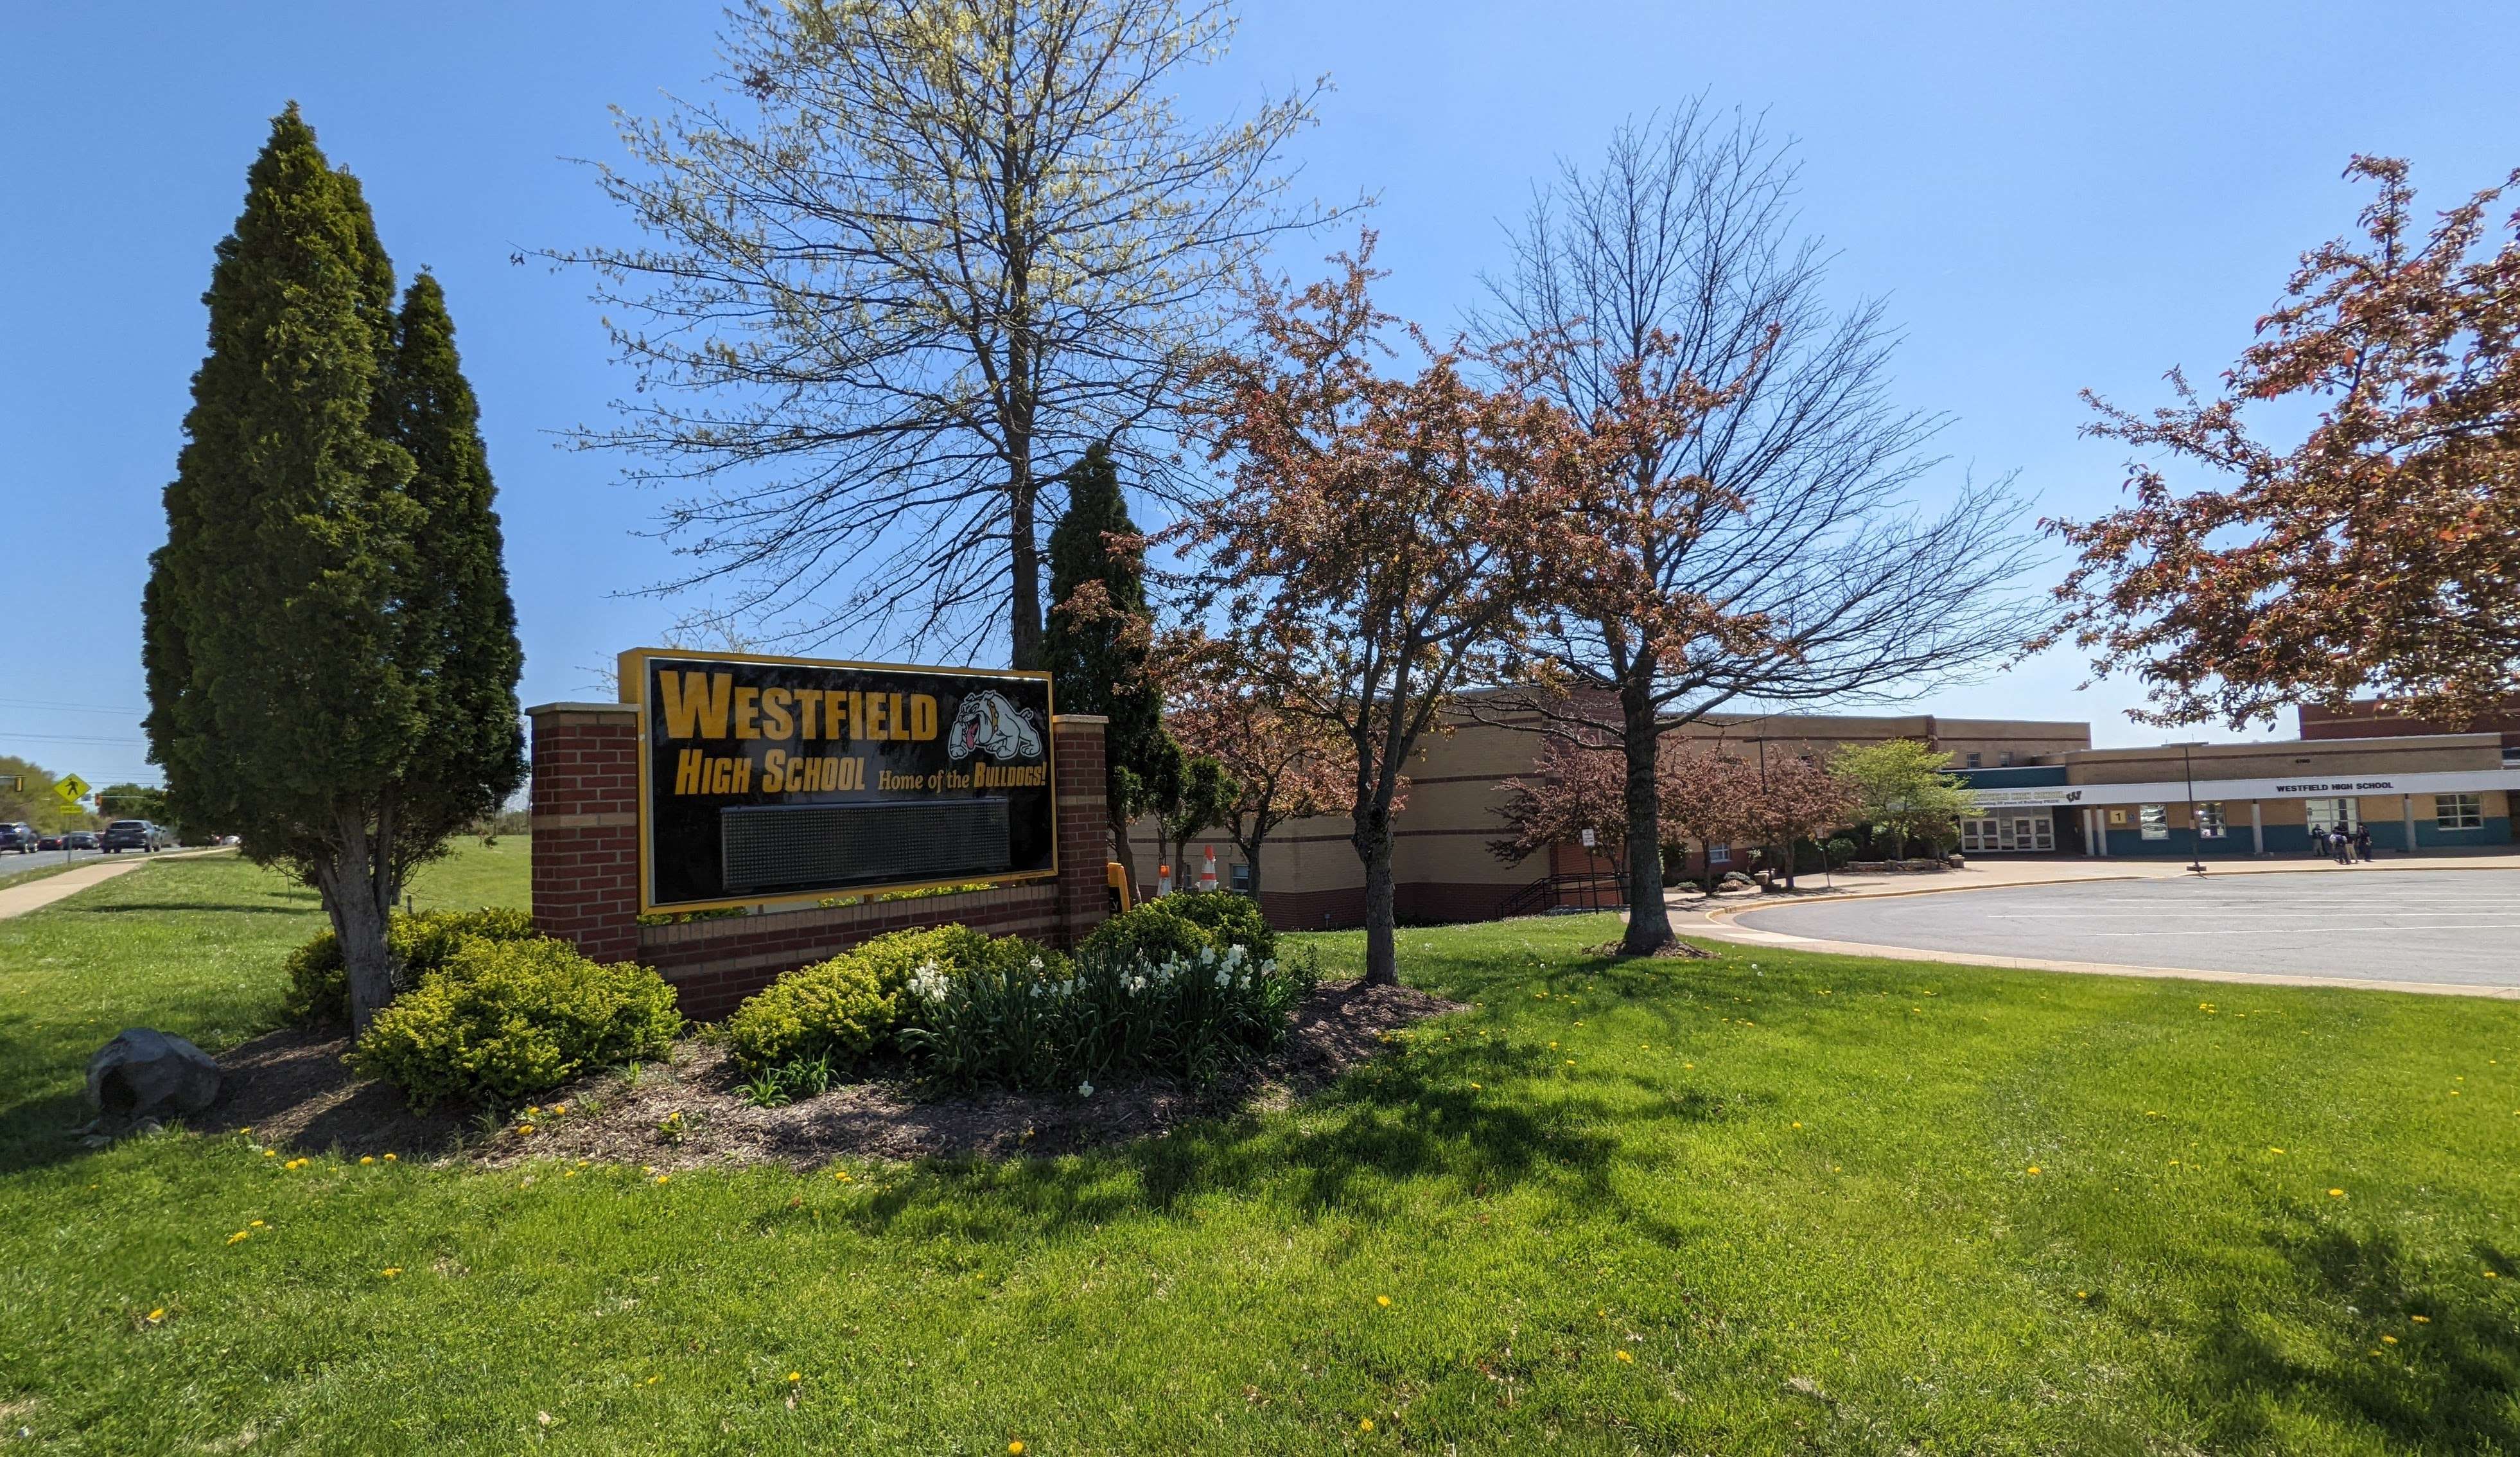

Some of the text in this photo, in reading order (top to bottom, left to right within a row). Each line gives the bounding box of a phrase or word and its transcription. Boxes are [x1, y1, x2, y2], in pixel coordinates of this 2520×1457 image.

[659, 670, 938, 740] WESTFIELD
[675, 748, 866, 795] HIGH SCHOOL
[878, 761, 1047, 793] Home of the BULLDOGS!
[2277, 784, 2328, 792] WESTFIELD
[2034, 791, 2066, 800] SCHOOL
[2066, 790, 2081, 802] W
[2115, 813, 2121, 821] 1
